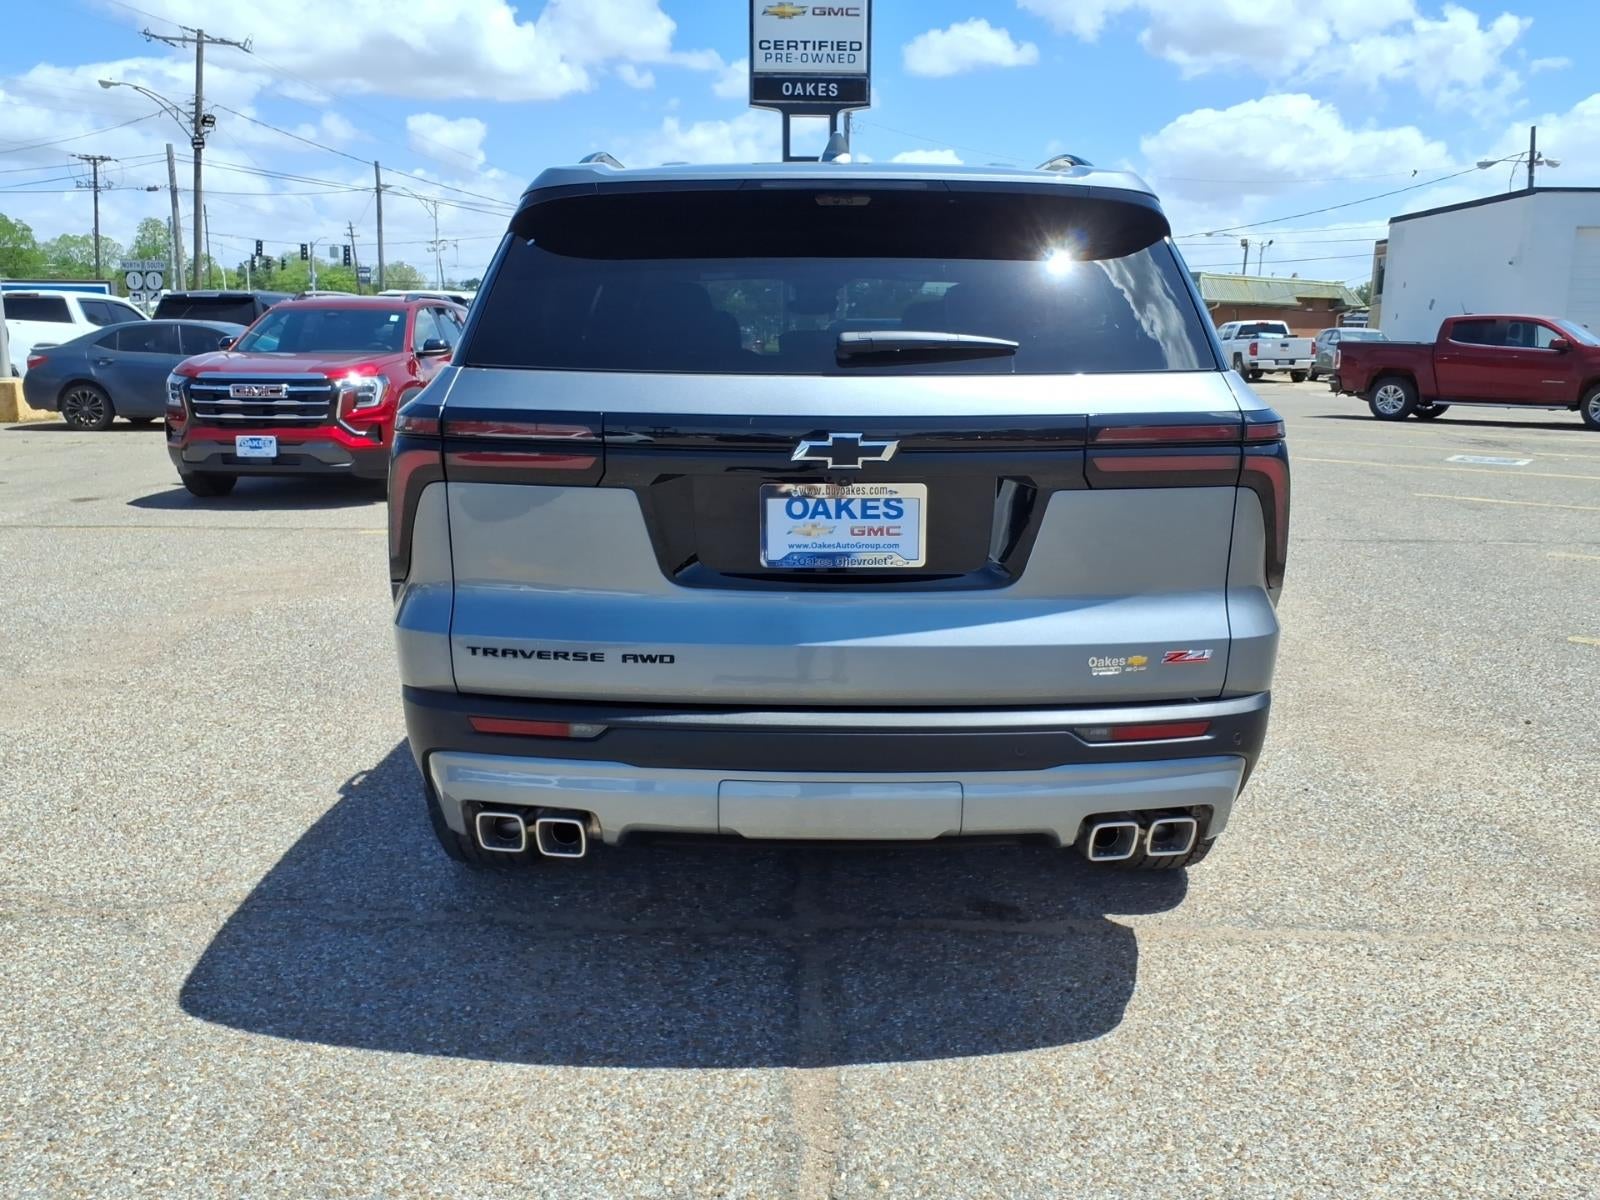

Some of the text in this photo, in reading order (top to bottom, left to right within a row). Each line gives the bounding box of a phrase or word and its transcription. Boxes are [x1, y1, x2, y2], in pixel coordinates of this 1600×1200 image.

[811, 7, 860, 17] GMC
[758, 39, 863, 52] CERTIFIED
[764, 52, 856, 64] PRE-OWNED
[781, 82, 839, 97] OAKES
[146, 261, 165, 269] SOUTH
[785, 497, 904, 520] OAKES
[850, 525, 903, 537] GMC
[788, 542, 900, 551] www.OakesAutoGroup.com
[466, 645, 675, 664] TRAVERSE AWD
[1088, 656, 1126, 667] Oakes
